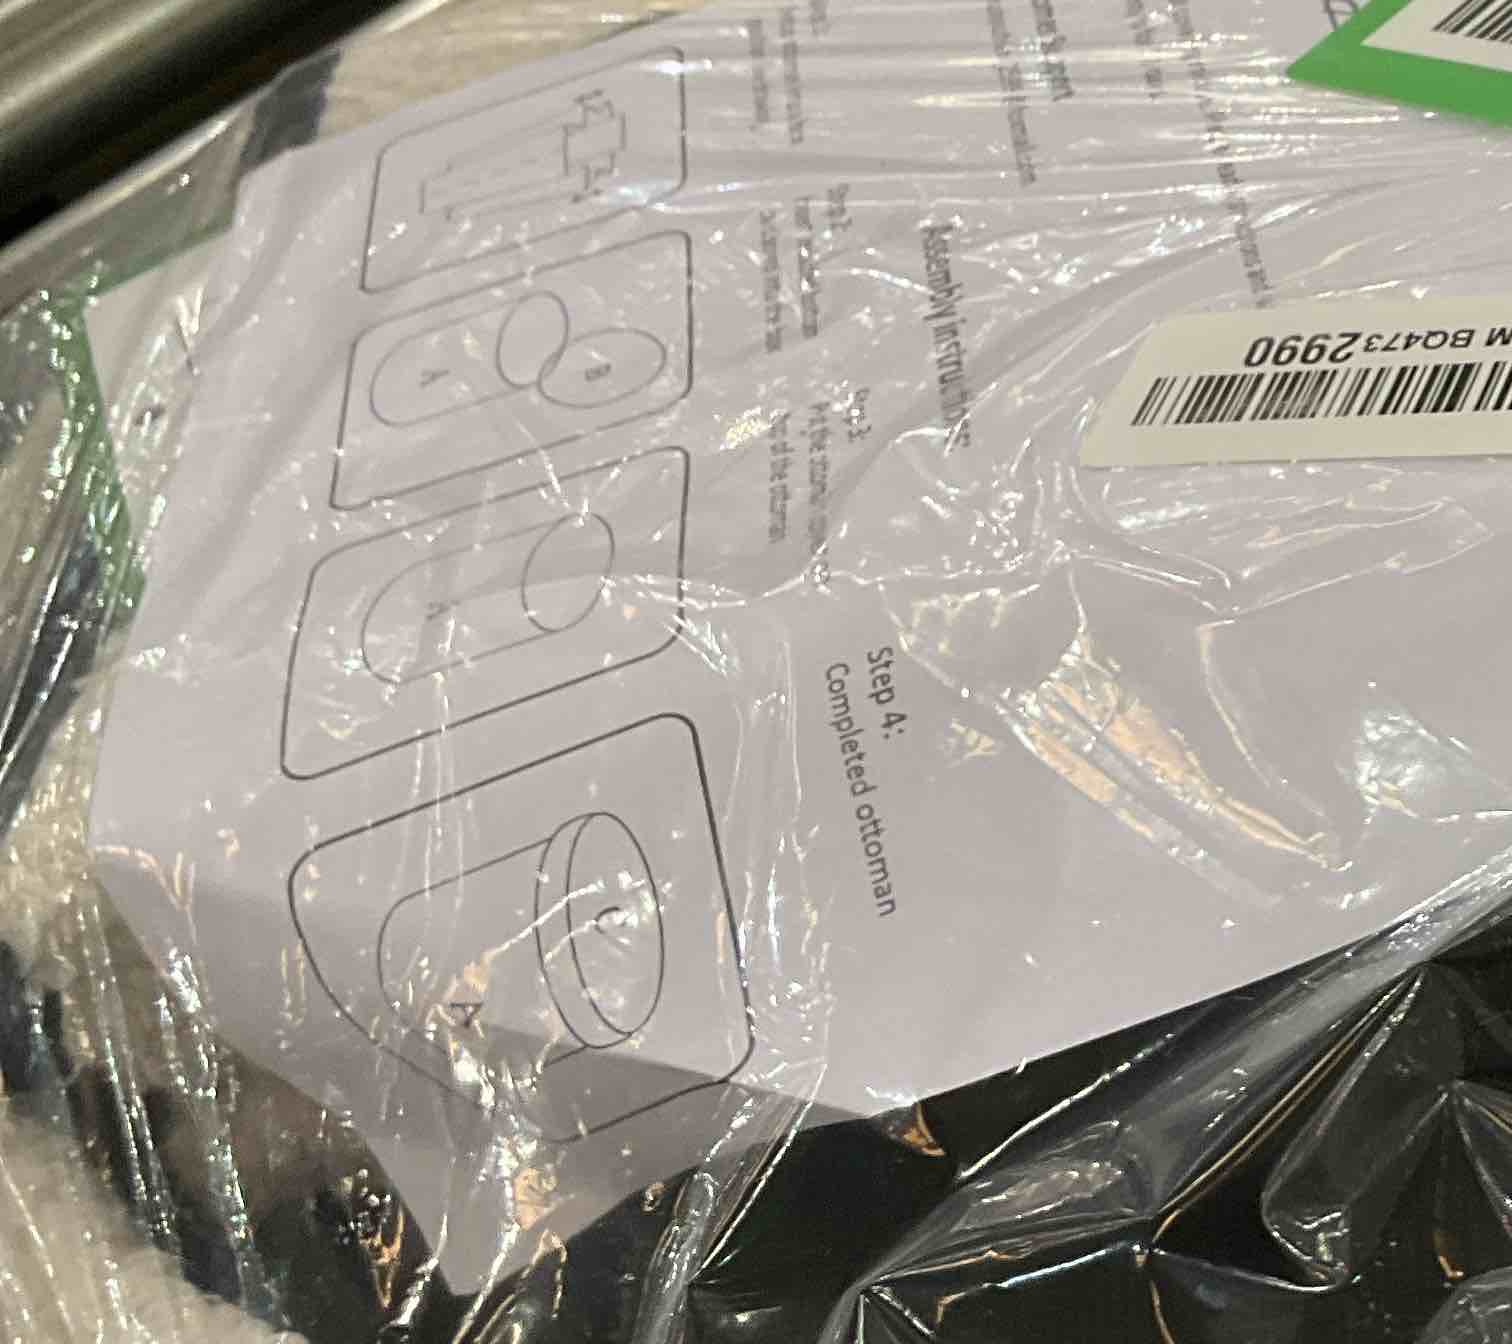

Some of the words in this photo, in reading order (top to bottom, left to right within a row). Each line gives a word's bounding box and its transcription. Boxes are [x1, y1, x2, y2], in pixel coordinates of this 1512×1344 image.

[920, 225, 963, 324] Assembly
[1242, 325, 1474, 371] BQ4732990
[866, 645, 895, 707] Step
[878, 711, 910, 741] 4:
[824, 662, 877, 797] Completed
[854, 800, 897, 918] ottoman
